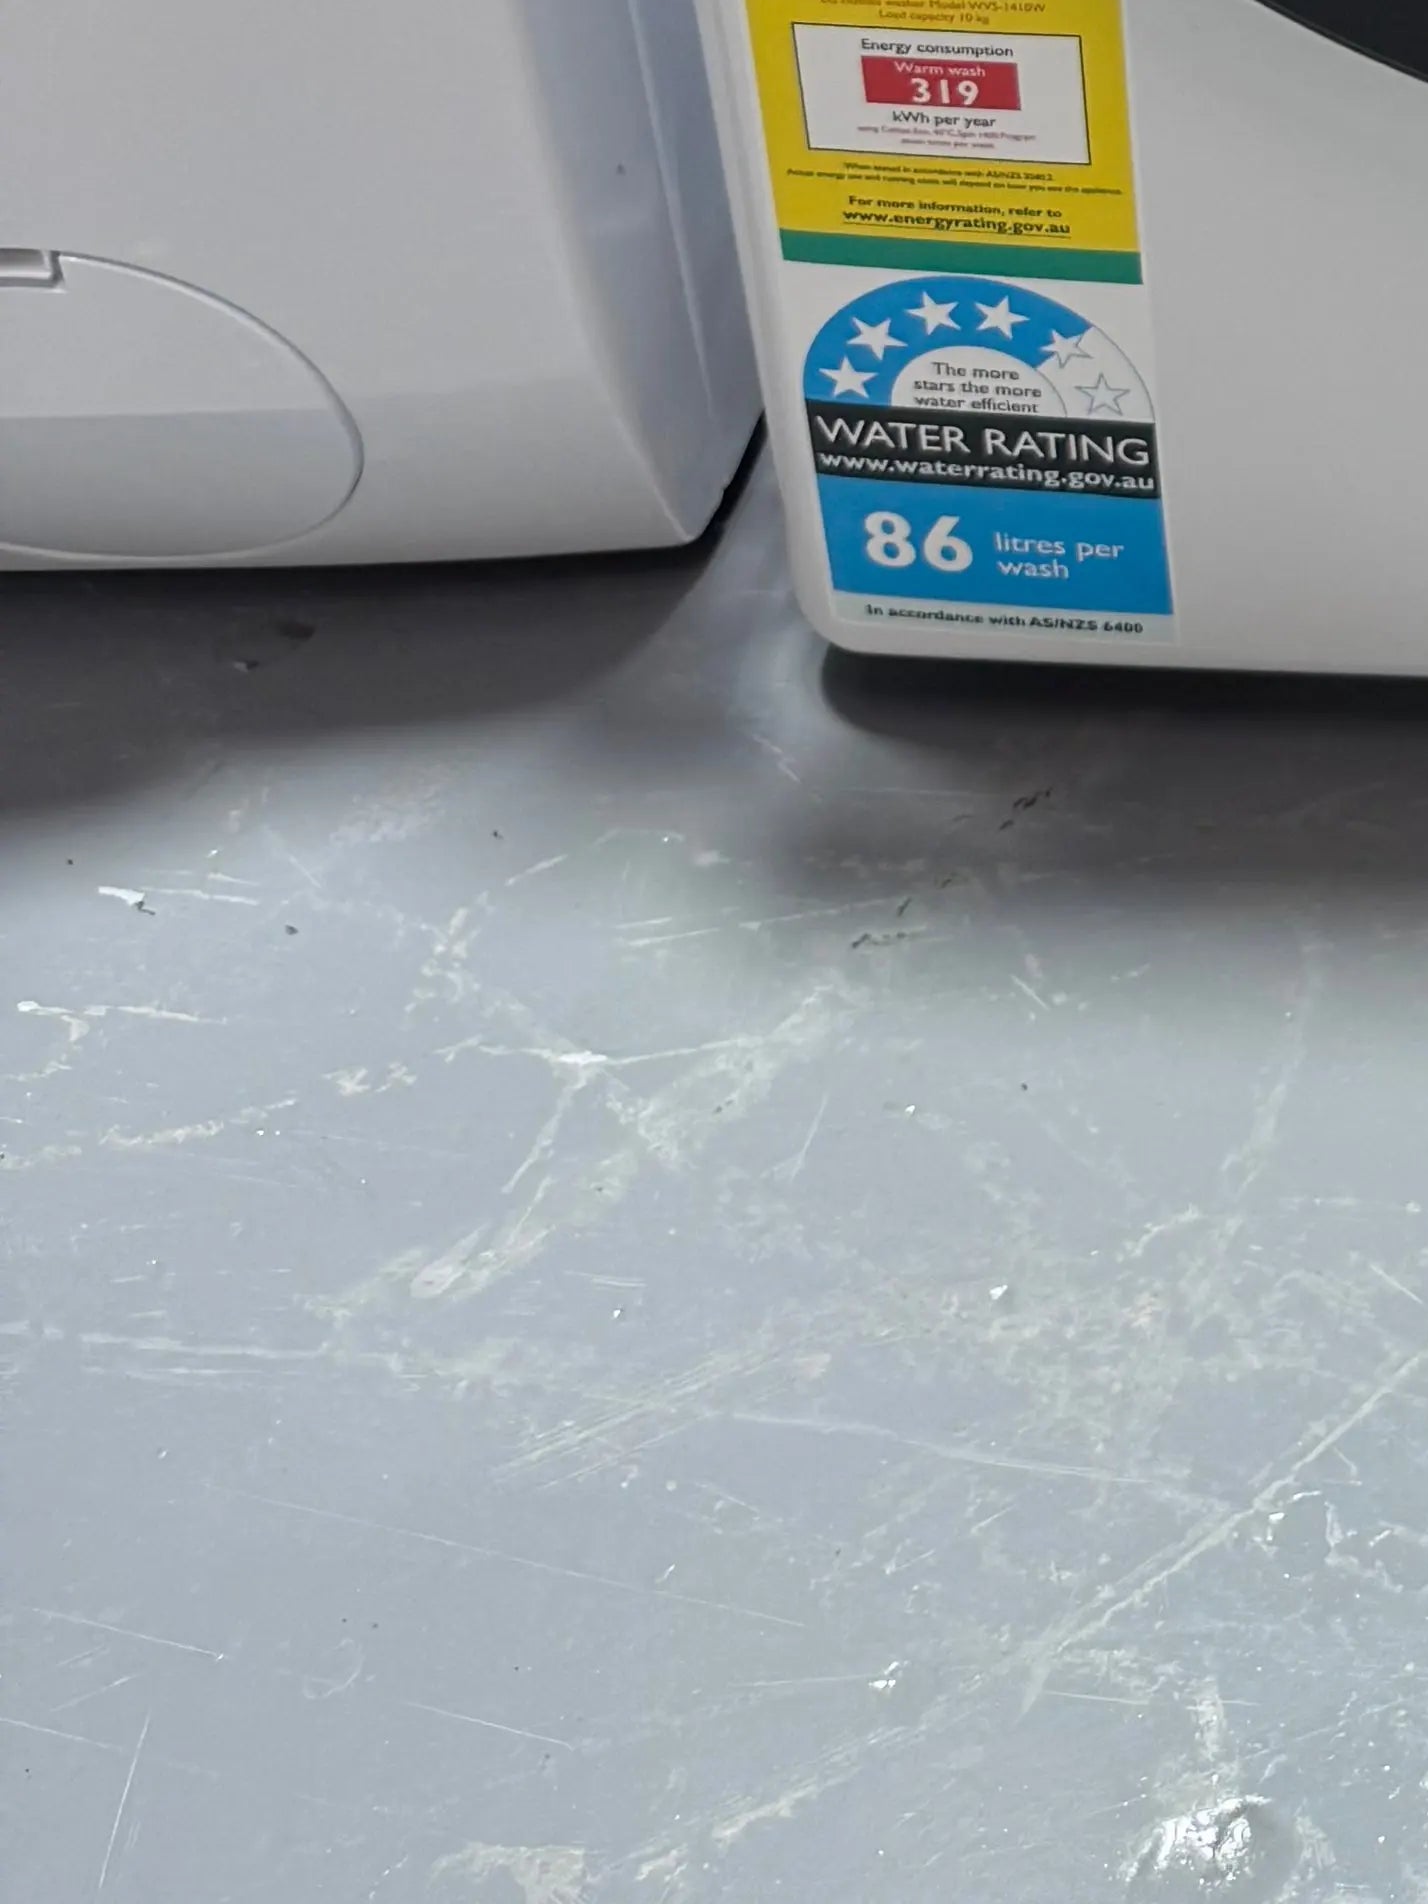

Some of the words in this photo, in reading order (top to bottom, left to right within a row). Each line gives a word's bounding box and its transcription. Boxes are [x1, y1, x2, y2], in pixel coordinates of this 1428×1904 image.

[860, 37, 912, 59] Energy
[916, 42, 1014, 60] consumption
[893, 61, 944, 77] Warm
[947, 62, 987, 78] wash
[911, 78, 980, 107] 319
[892, 110, 930, 127] kWh
[932, 115, 959, 131] per
[962, 115, 997, 132] year
[848, 195, 875, 207] For
[877, 198, 916, 210] more
[1047, 208, 1063, 219] to
[842, 209, 1072, 236] www.energyrating.gov.au
[932, 361, 968, 379] The
[971, 366, 1020, 381] more
[913, 378, 956, 395] stars
[960, 381, 991, 397] the
[994, 384, 1043, 399] more
[913, 396, 965, 411] water
[968, 396, 1040, 414] efficient
[814, 415, 970, 455] WATER
[984, 428, 1150, 467] RATING
[819, 452, 1155, 490] www.waterrating.gov.au
[863, 510, 974, 574] 86
[993, 531, 1067, 556] litres
[1075, 541, 1125, 563] per
[995, 558, 1071, 580] wash
[988, 612, 1027, 627] with
